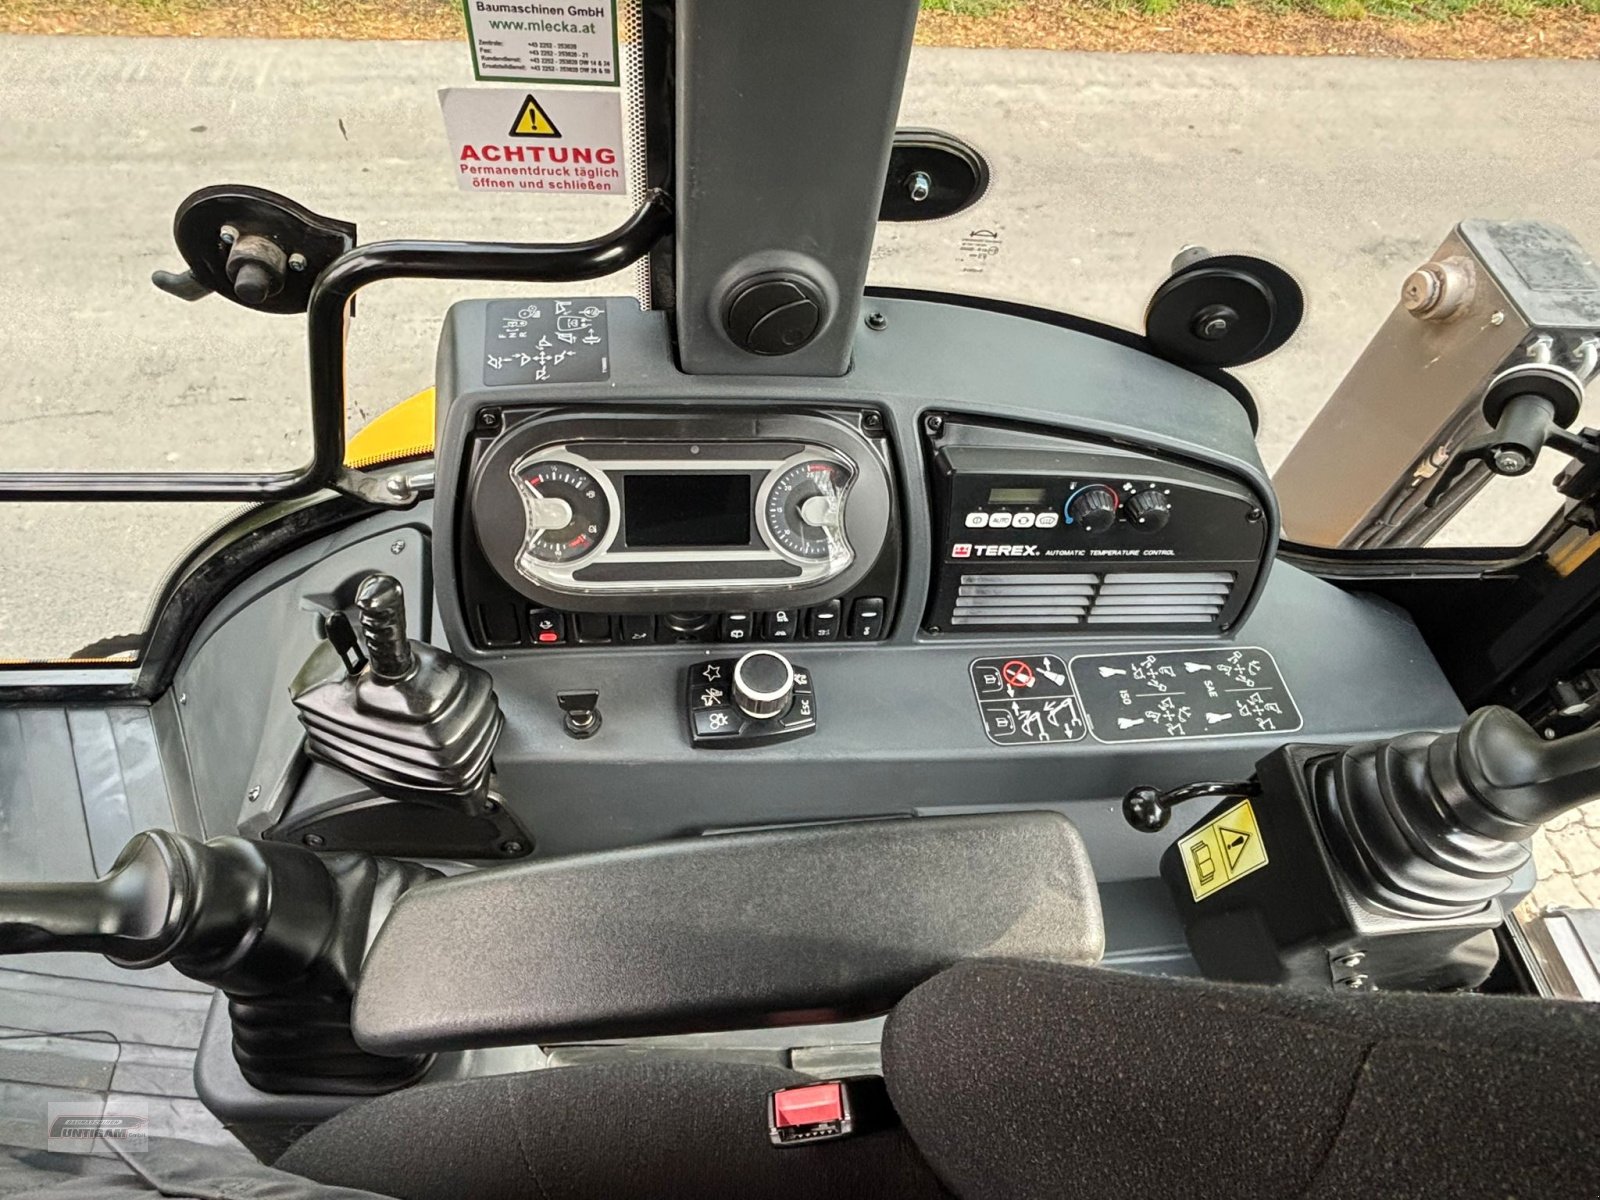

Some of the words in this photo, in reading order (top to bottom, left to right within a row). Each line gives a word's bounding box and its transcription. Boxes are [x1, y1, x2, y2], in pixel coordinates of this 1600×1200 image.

[476, 1, 564, 15] Baumaschinen
[568, 6, 604, 17] GmbH
[489, 20, 595, 34] www.mlecka.at
[460, 145, 615, 165] ACHTUNG
[460, 164, 570, 177] Permanentdruck
[575, 166, 619, 179] täglich
[473, 177, 514, 188] öffnen
[520, 179, 544, 189] und
[548, 180, 611, 190] schließen
[1119, 689, 1132, 705] ISO
[1203, 680, 1218, 698] SAE
